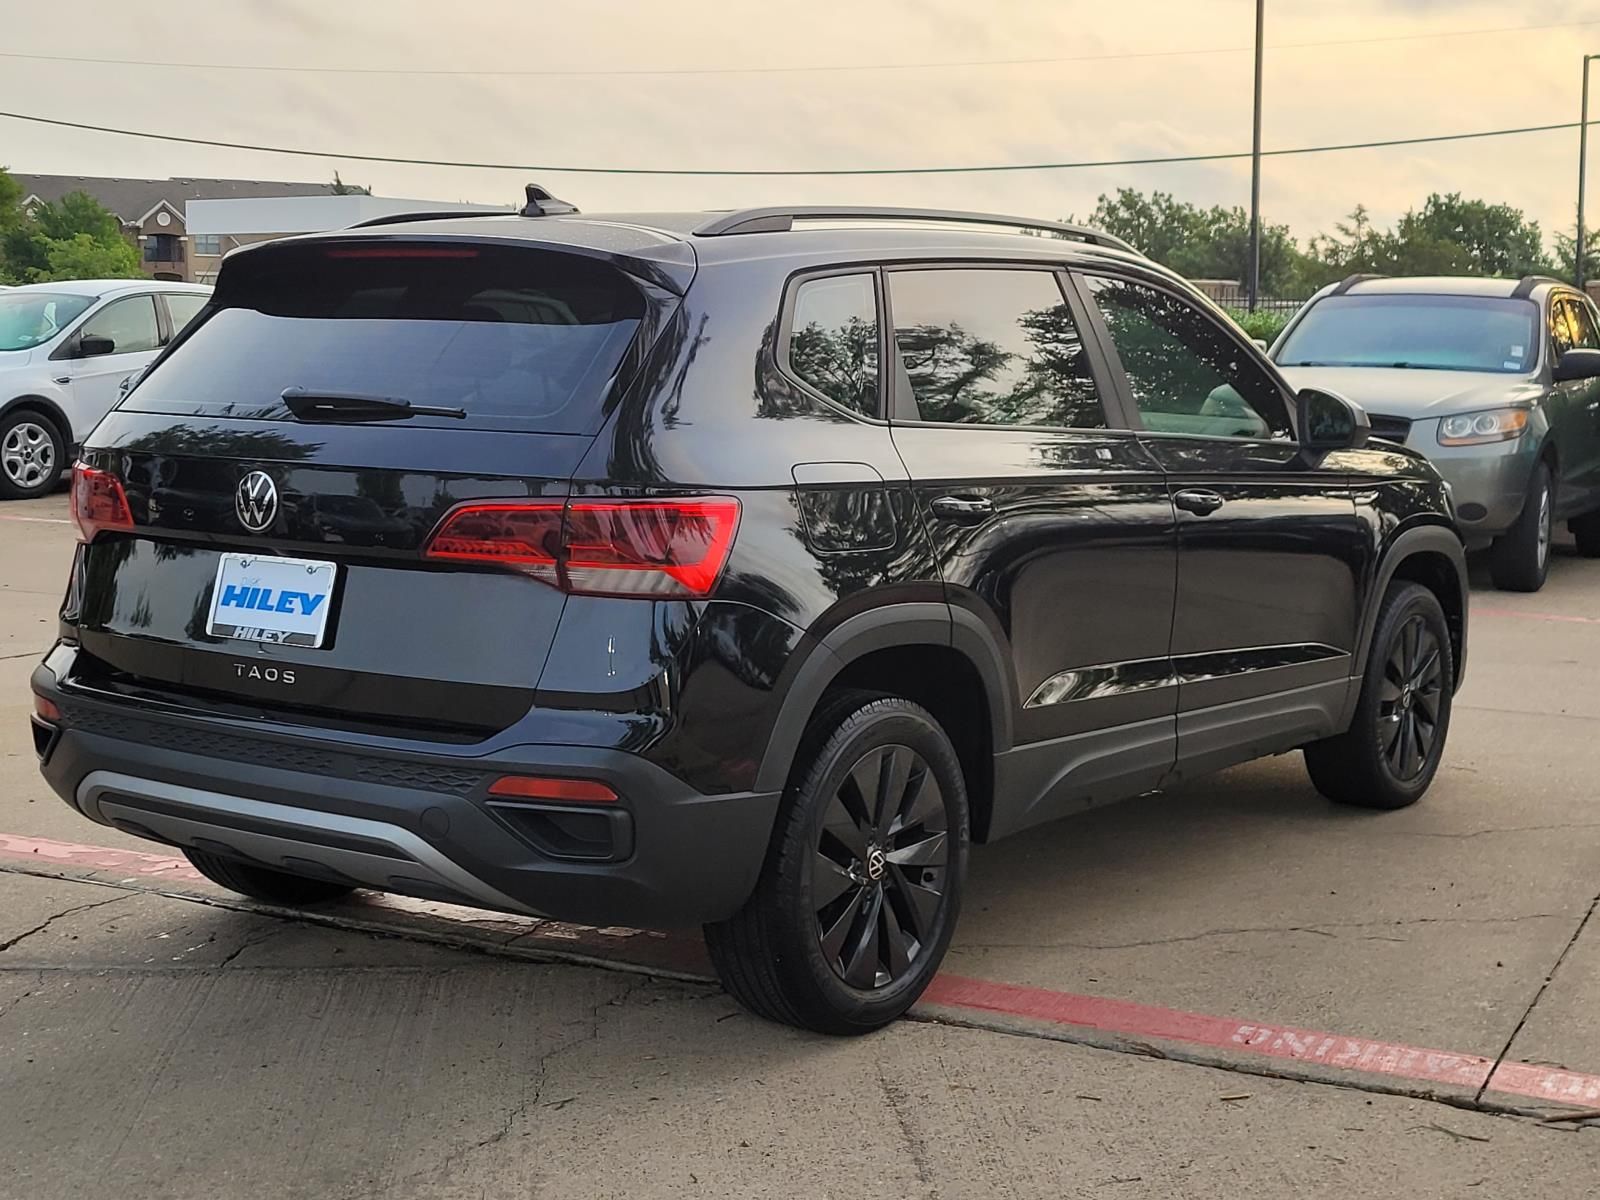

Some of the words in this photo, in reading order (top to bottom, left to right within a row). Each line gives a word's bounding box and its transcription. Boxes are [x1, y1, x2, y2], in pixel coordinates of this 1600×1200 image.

[221, 584, 326, 616] HILEY
[232, 626, 292, 643] HILEY
[233, 663, 296, 684] TAOS
